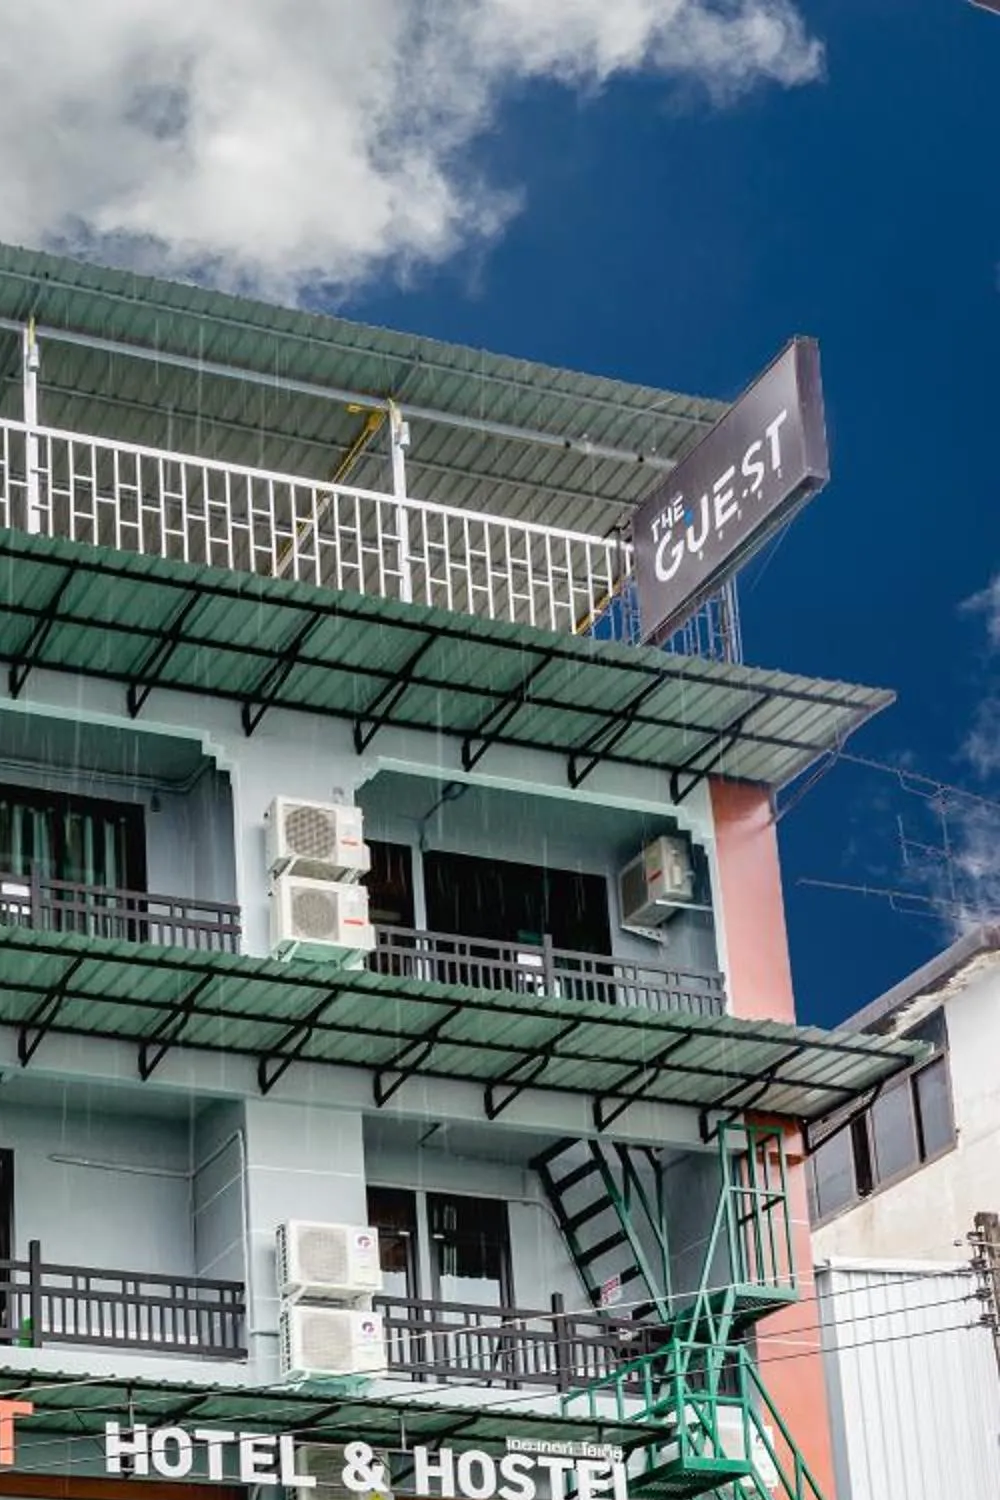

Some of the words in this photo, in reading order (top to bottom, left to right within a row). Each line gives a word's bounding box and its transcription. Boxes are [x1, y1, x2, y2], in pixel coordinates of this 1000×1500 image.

[650, 495, 685, 544] THE
[654, 408, 788, 582] GUEST
[105, 1421, 317, 1488] HOTEL
[341, 1441, 389, 1492] &
